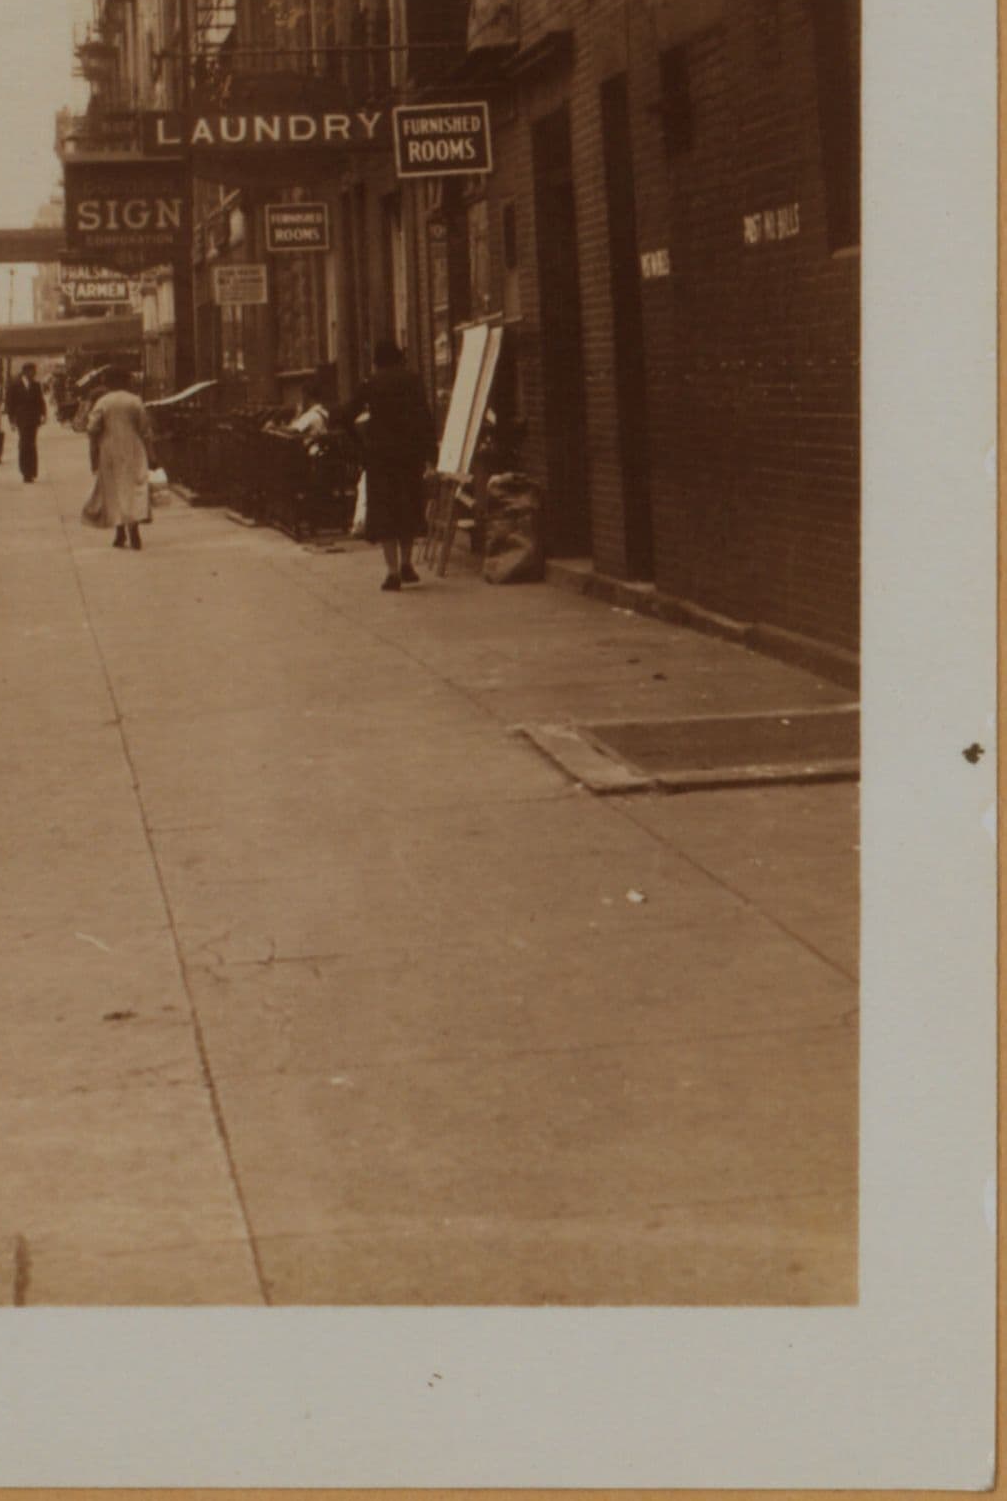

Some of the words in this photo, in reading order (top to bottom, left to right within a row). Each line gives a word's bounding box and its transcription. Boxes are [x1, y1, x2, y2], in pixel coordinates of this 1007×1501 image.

[156, 111, 383, 145] LAUNDRY
[402, 115, 482, 136] FURNISHED
[407, 138, 476, 163] ROOMS
[76, 199, 182, 231] SIGN
[274, 227, 320, 242] ROOMS
